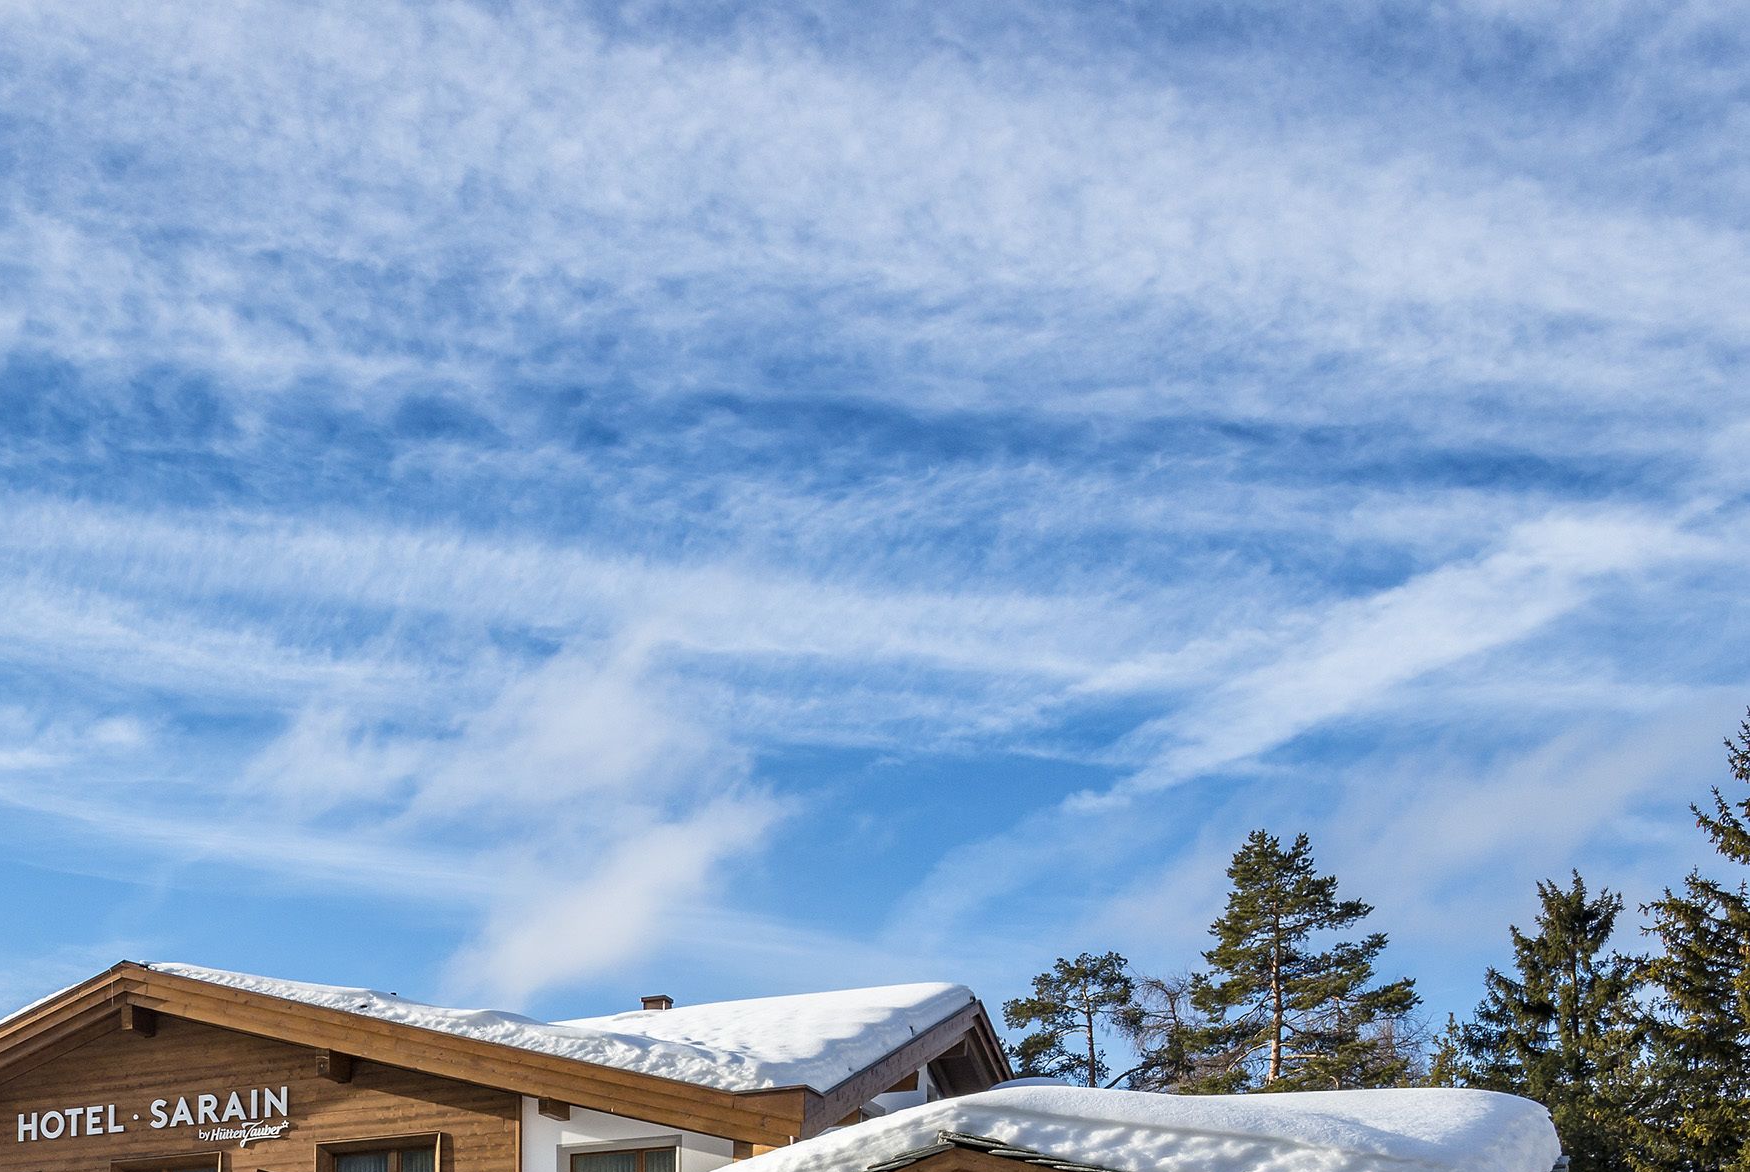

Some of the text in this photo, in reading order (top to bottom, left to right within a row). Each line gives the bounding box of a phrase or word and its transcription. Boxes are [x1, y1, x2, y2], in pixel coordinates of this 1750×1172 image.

[18, 1104, 125, 1142] HOTEL
[149, 1086, 288, 1129] SARAIN
[198, 1129, 211, 1141] by
